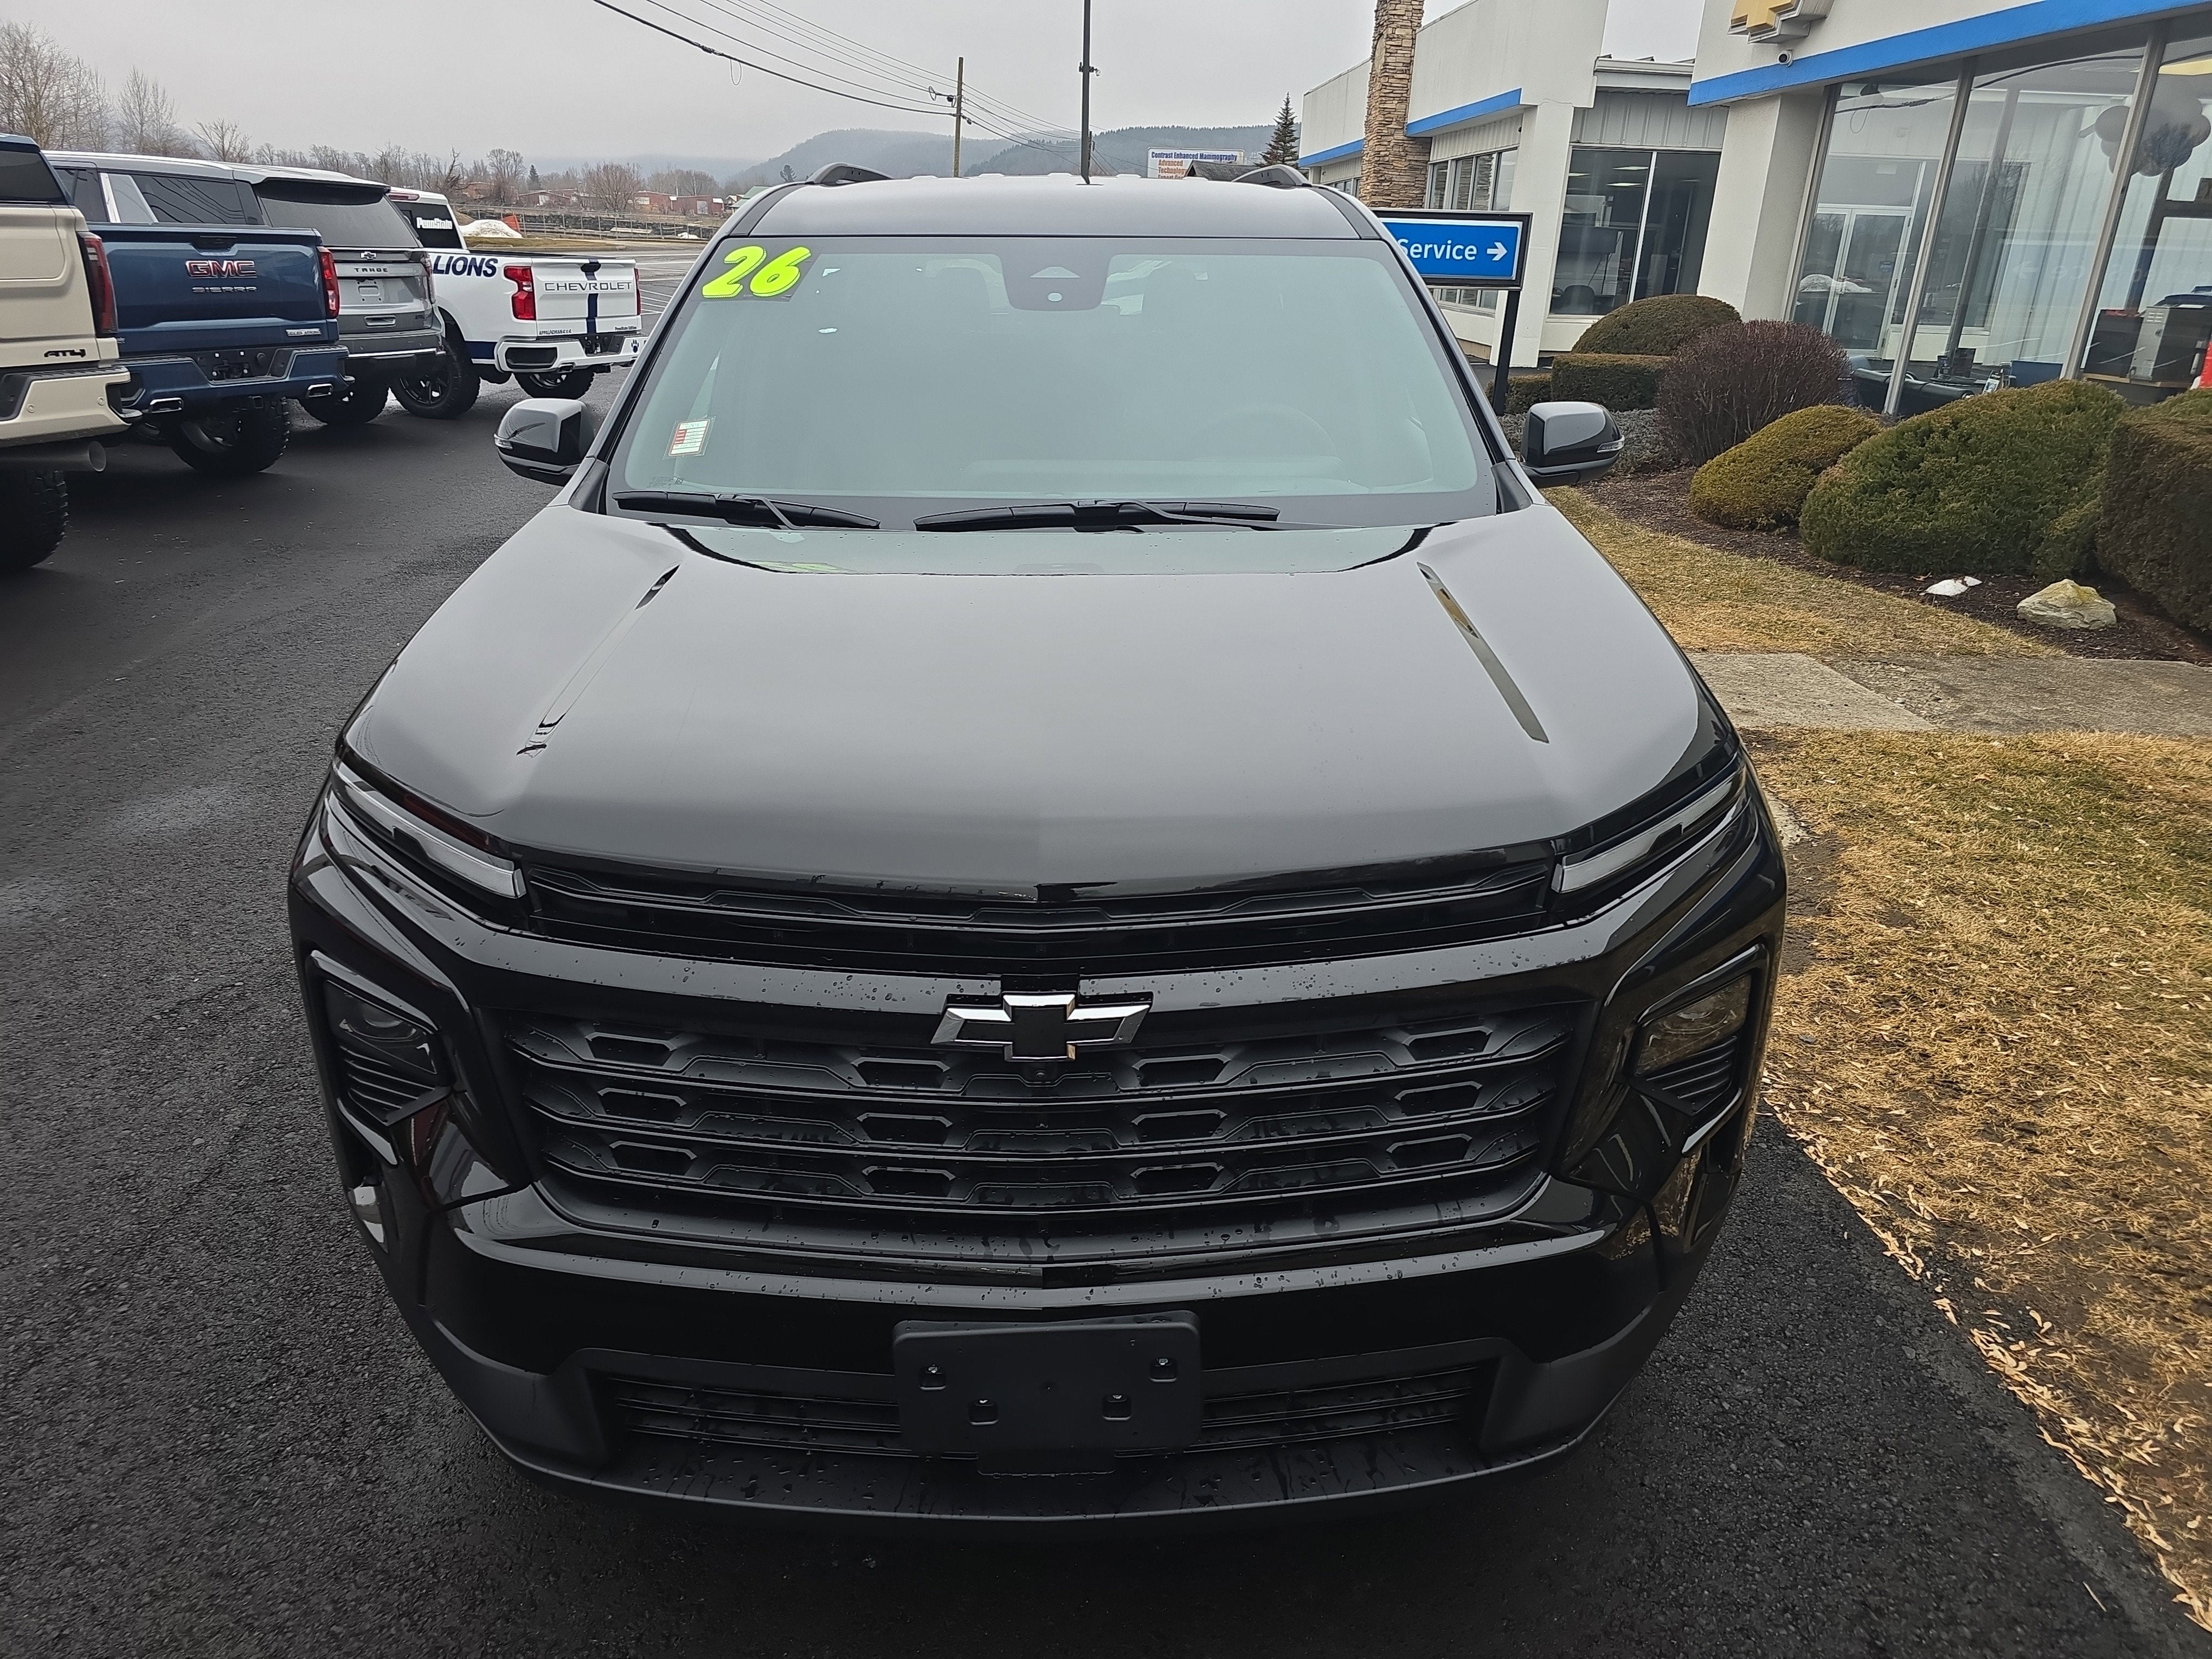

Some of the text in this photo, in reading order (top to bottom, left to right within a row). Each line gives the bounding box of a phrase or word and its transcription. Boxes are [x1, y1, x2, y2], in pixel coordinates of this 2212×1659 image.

[1174, 152, 1198, 160] Enhanced
[1199, 153, 1237, 162] Mammography
[1397, 238, 1477, 260] Service
[185, 260, 258, 279] GMC
[433, 255, 498, 278] LIONS
[702, 246, 812, 298] 26
[544, 282, 632, 291] CHEVROLET
[44, 349, 87, 358] AT4
